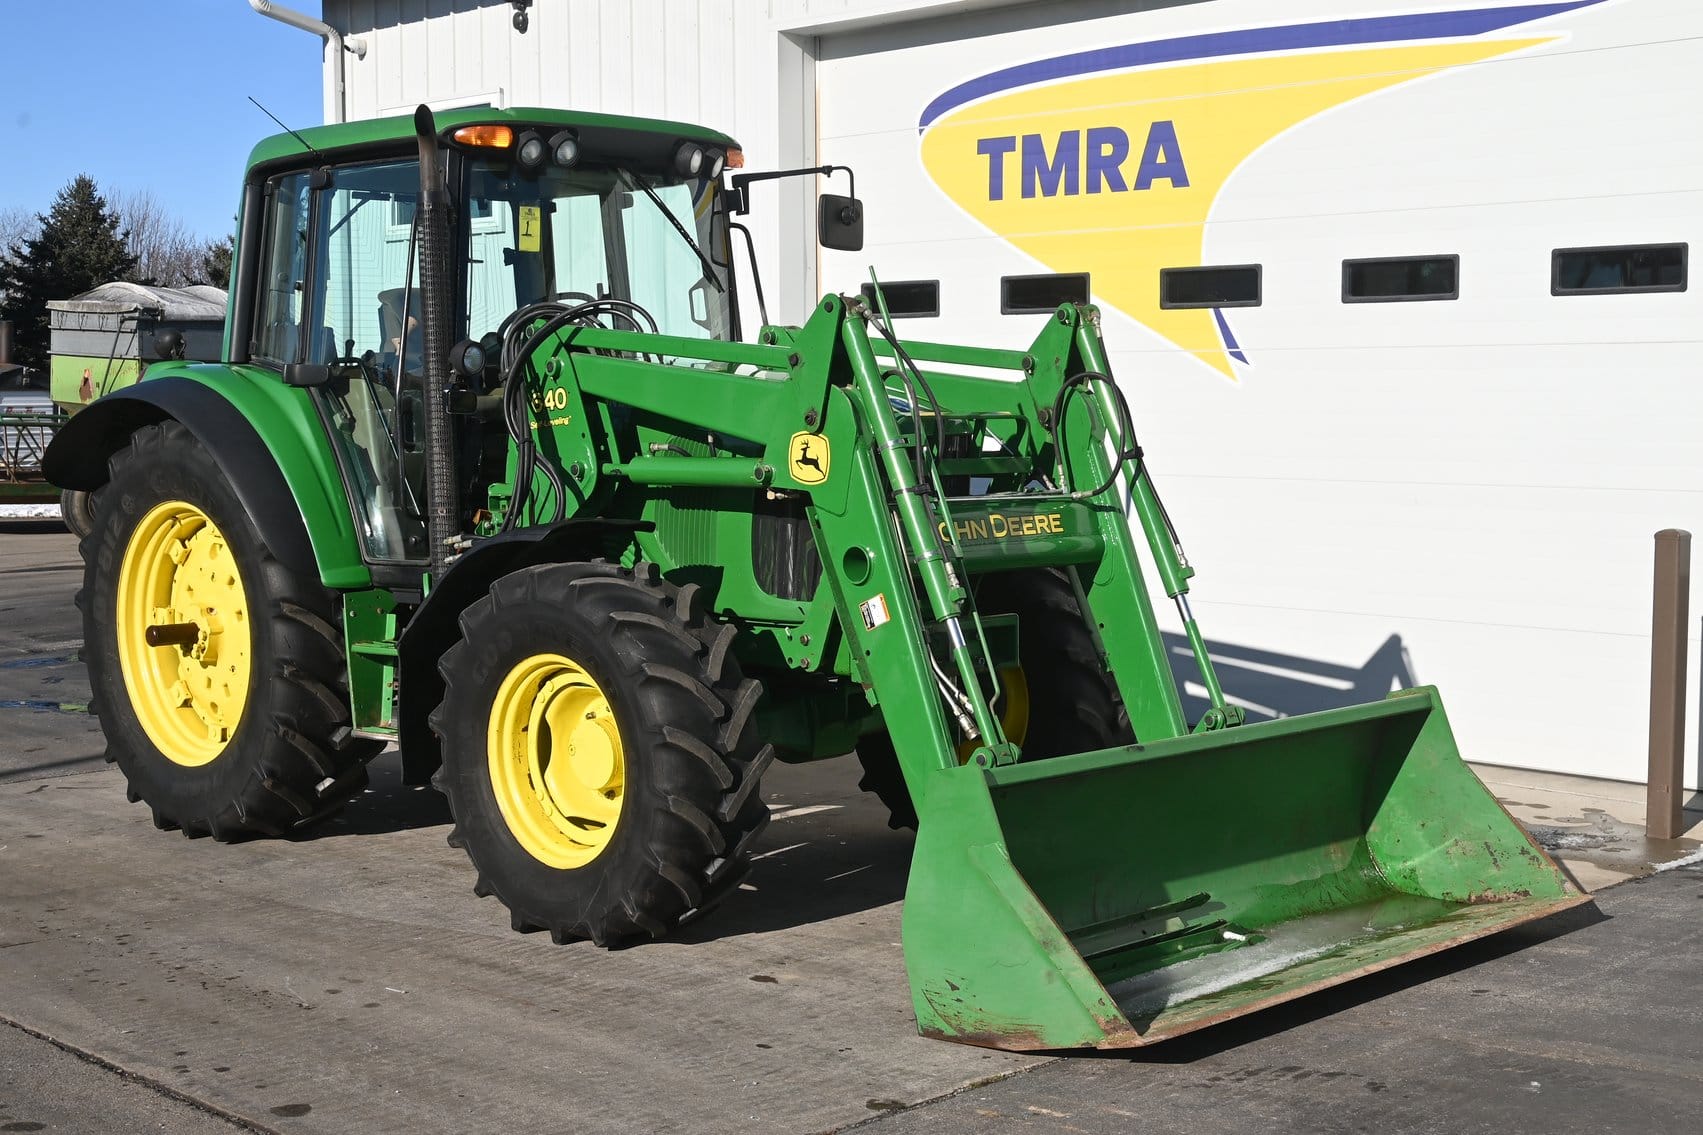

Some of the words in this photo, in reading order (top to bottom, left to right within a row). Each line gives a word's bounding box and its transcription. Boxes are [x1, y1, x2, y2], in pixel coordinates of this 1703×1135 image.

[977, 120, 1190, 201] TMRA
[521, 220, 532, 237] 1
[937, 519, 989, 542] OHN
[988, 513, 1064, 538] DEERE
